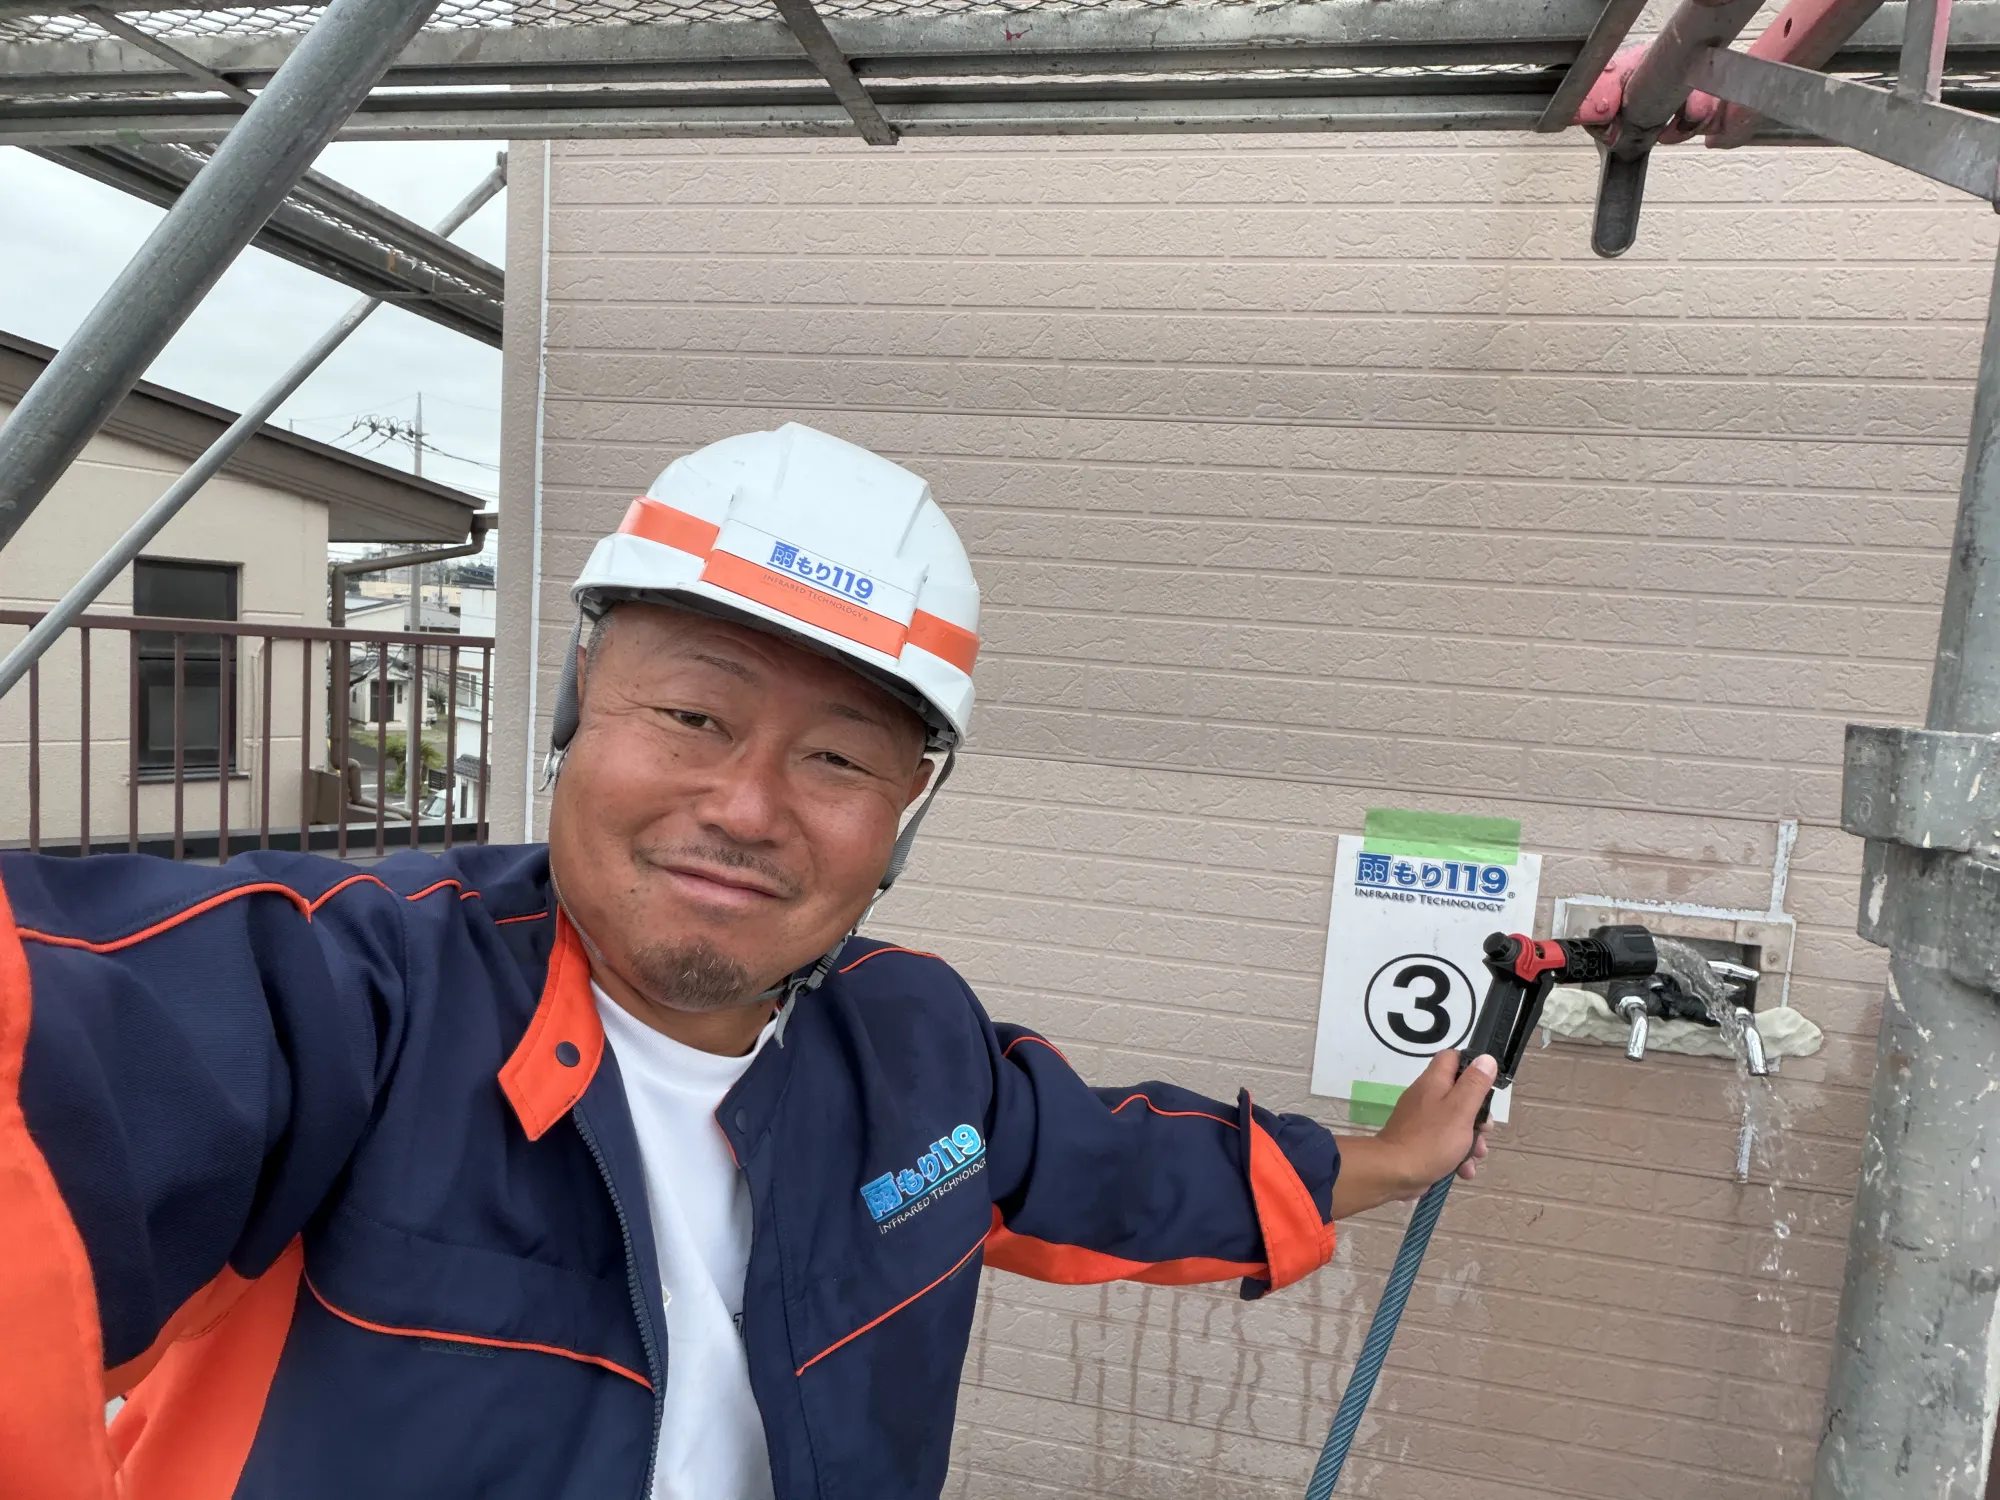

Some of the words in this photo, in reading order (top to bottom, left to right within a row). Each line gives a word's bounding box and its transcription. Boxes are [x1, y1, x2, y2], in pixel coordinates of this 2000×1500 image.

[763, 573, 806, 594] INFRARED
[770, 540, 874, 600] 雨もり119
[1355, 851, 1510, 896] 雨もり119
[1354, 887, 1415, 903] INFRARED
[1418, 894, 1504, 912] TECHNOLOGY
[859, 1123, 982, 1220] 雨もり119
[879, 1196, 930, 1234] INFRARED
